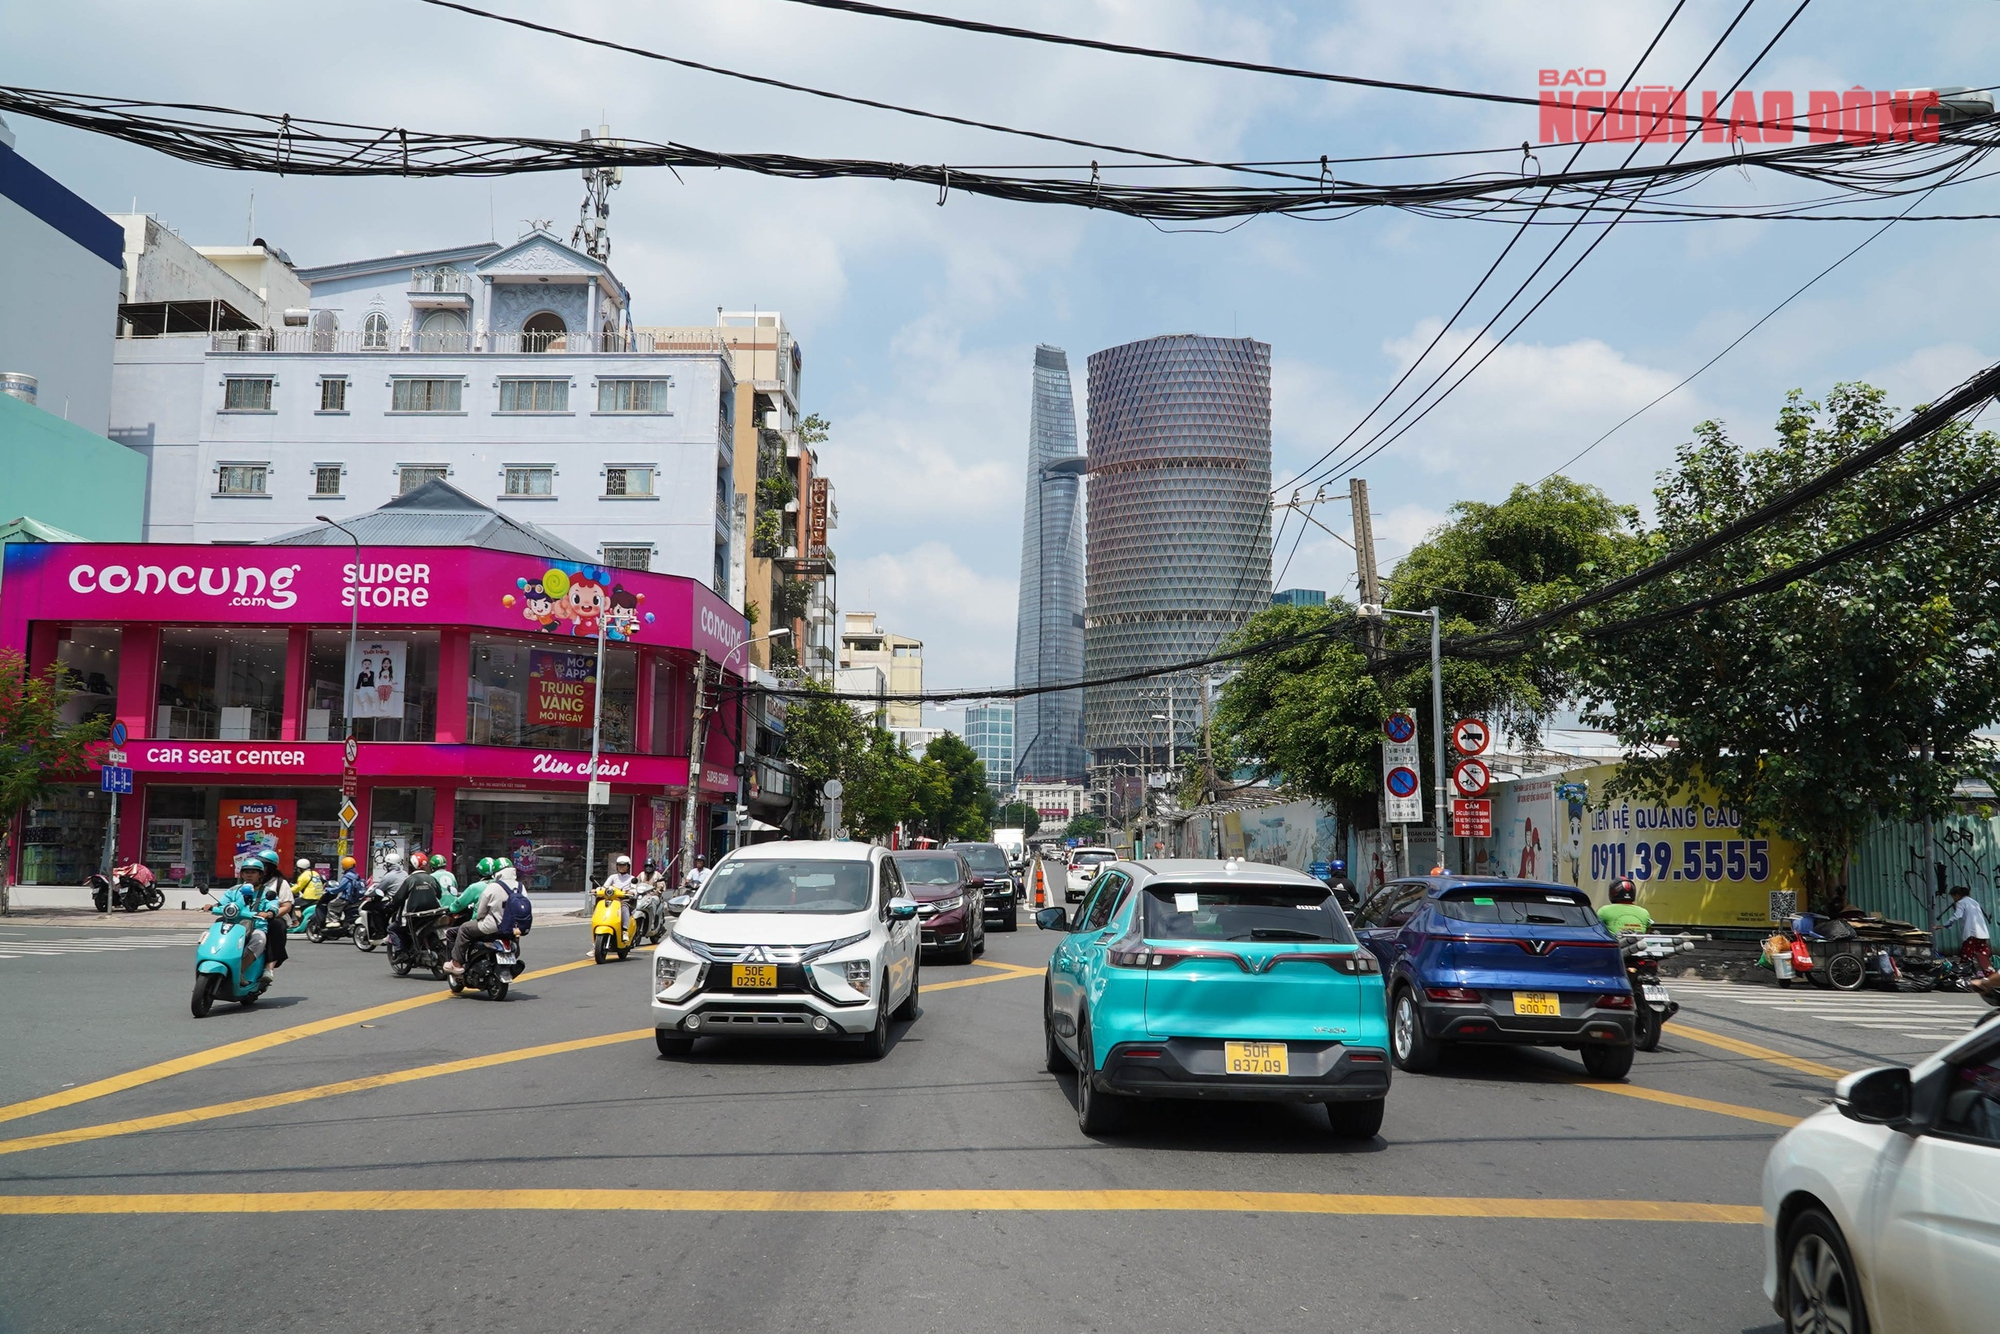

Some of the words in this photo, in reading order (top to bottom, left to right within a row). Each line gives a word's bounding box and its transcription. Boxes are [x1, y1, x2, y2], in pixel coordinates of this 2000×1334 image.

[813, 481, 826, 542] HOTEL
[540, 681, 584, 696] TRÚNG
[540, 694, 584, 713] VÀNG
[533, 754, 573, 773] Xin
[1464, 801, 1480, 809] CẤM
[1613, 804, 1630, 835] HỆ
[1592, 841, 1769, 881] 0911.39.5555
[745, 966, 764, 976] 50E
[737, 977, 772, 987] 029.64
[1526, 993, 1546, 1003] 50H
[1520, 1004, 1555, 1014] 900.70
[1243, 1045, 1269, 1058] 50H
[1233, 1059, 1281, 1073] 837.09
